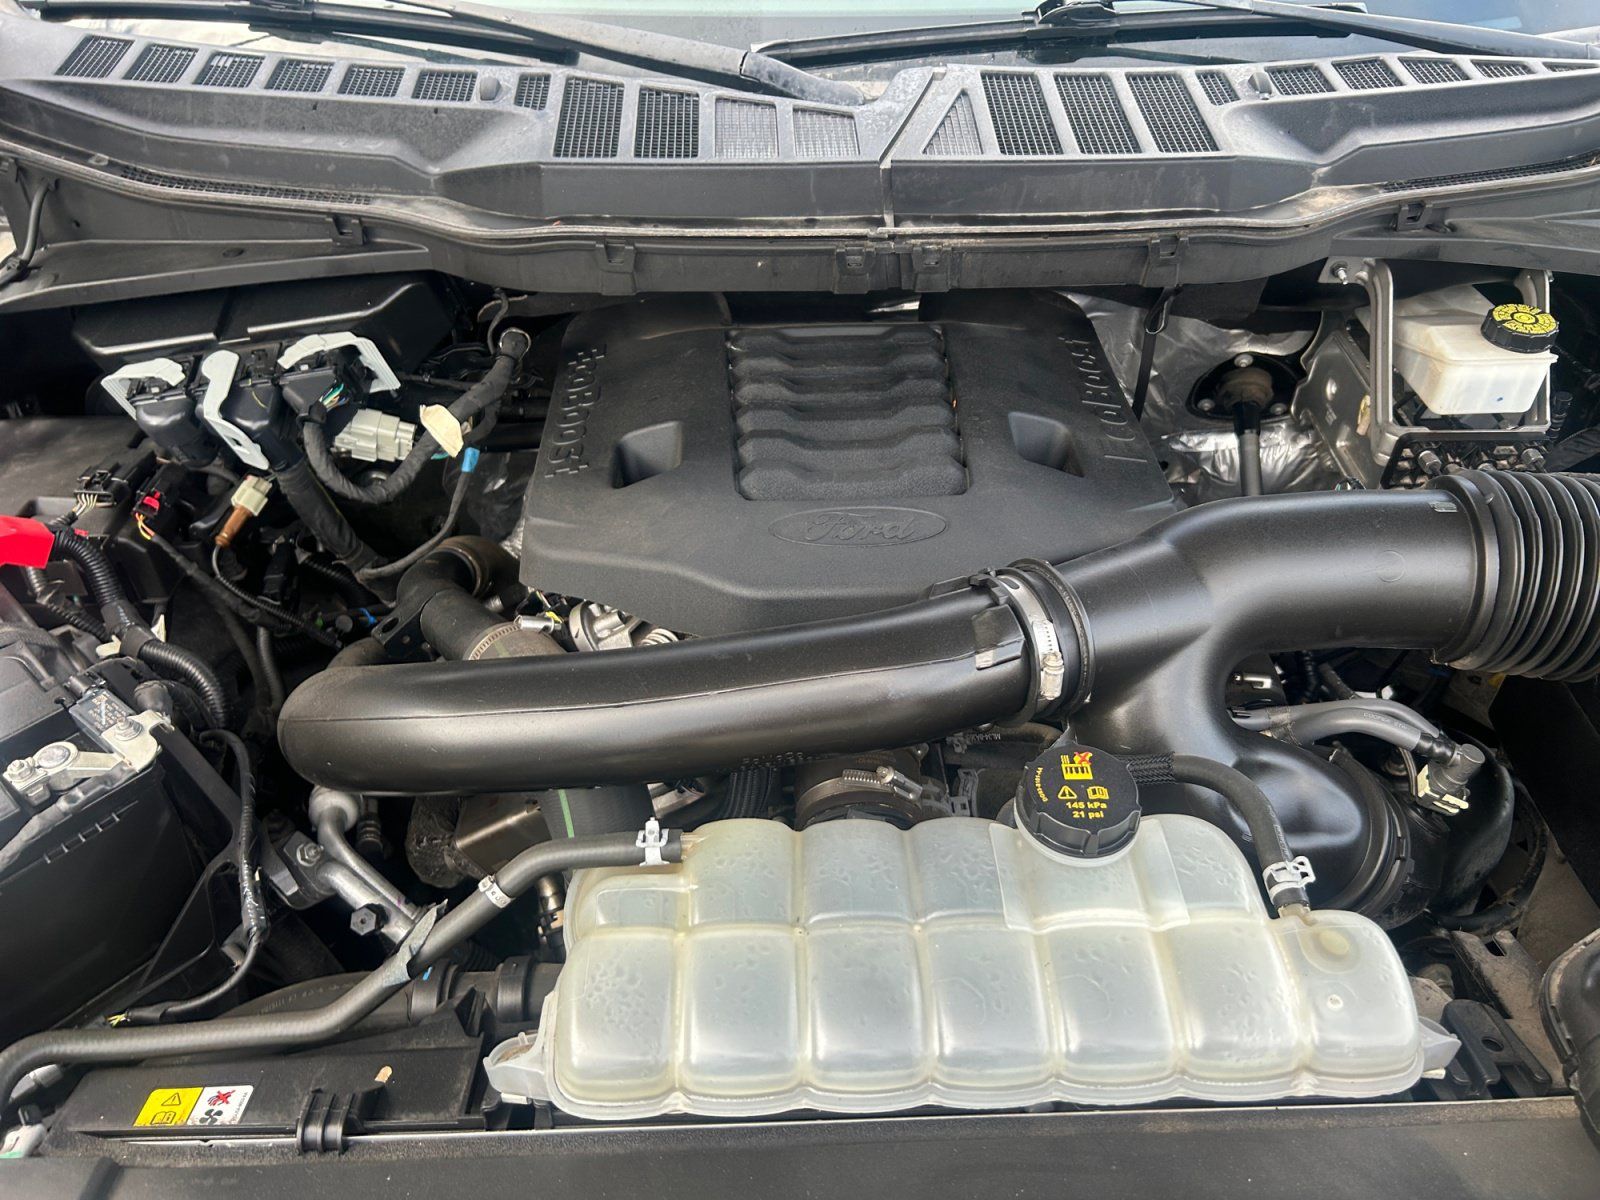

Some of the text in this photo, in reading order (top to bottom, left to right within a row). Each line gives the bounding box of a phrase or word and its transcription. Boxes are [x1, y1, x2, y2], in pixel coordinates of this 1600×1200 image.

[544, 344, 607, 478] EcoBoost
[1058, 336, 1148, 463] EcoBoost
[804, 511, 917, 542] Ford
[1089, 811, 1104, 819] psi
